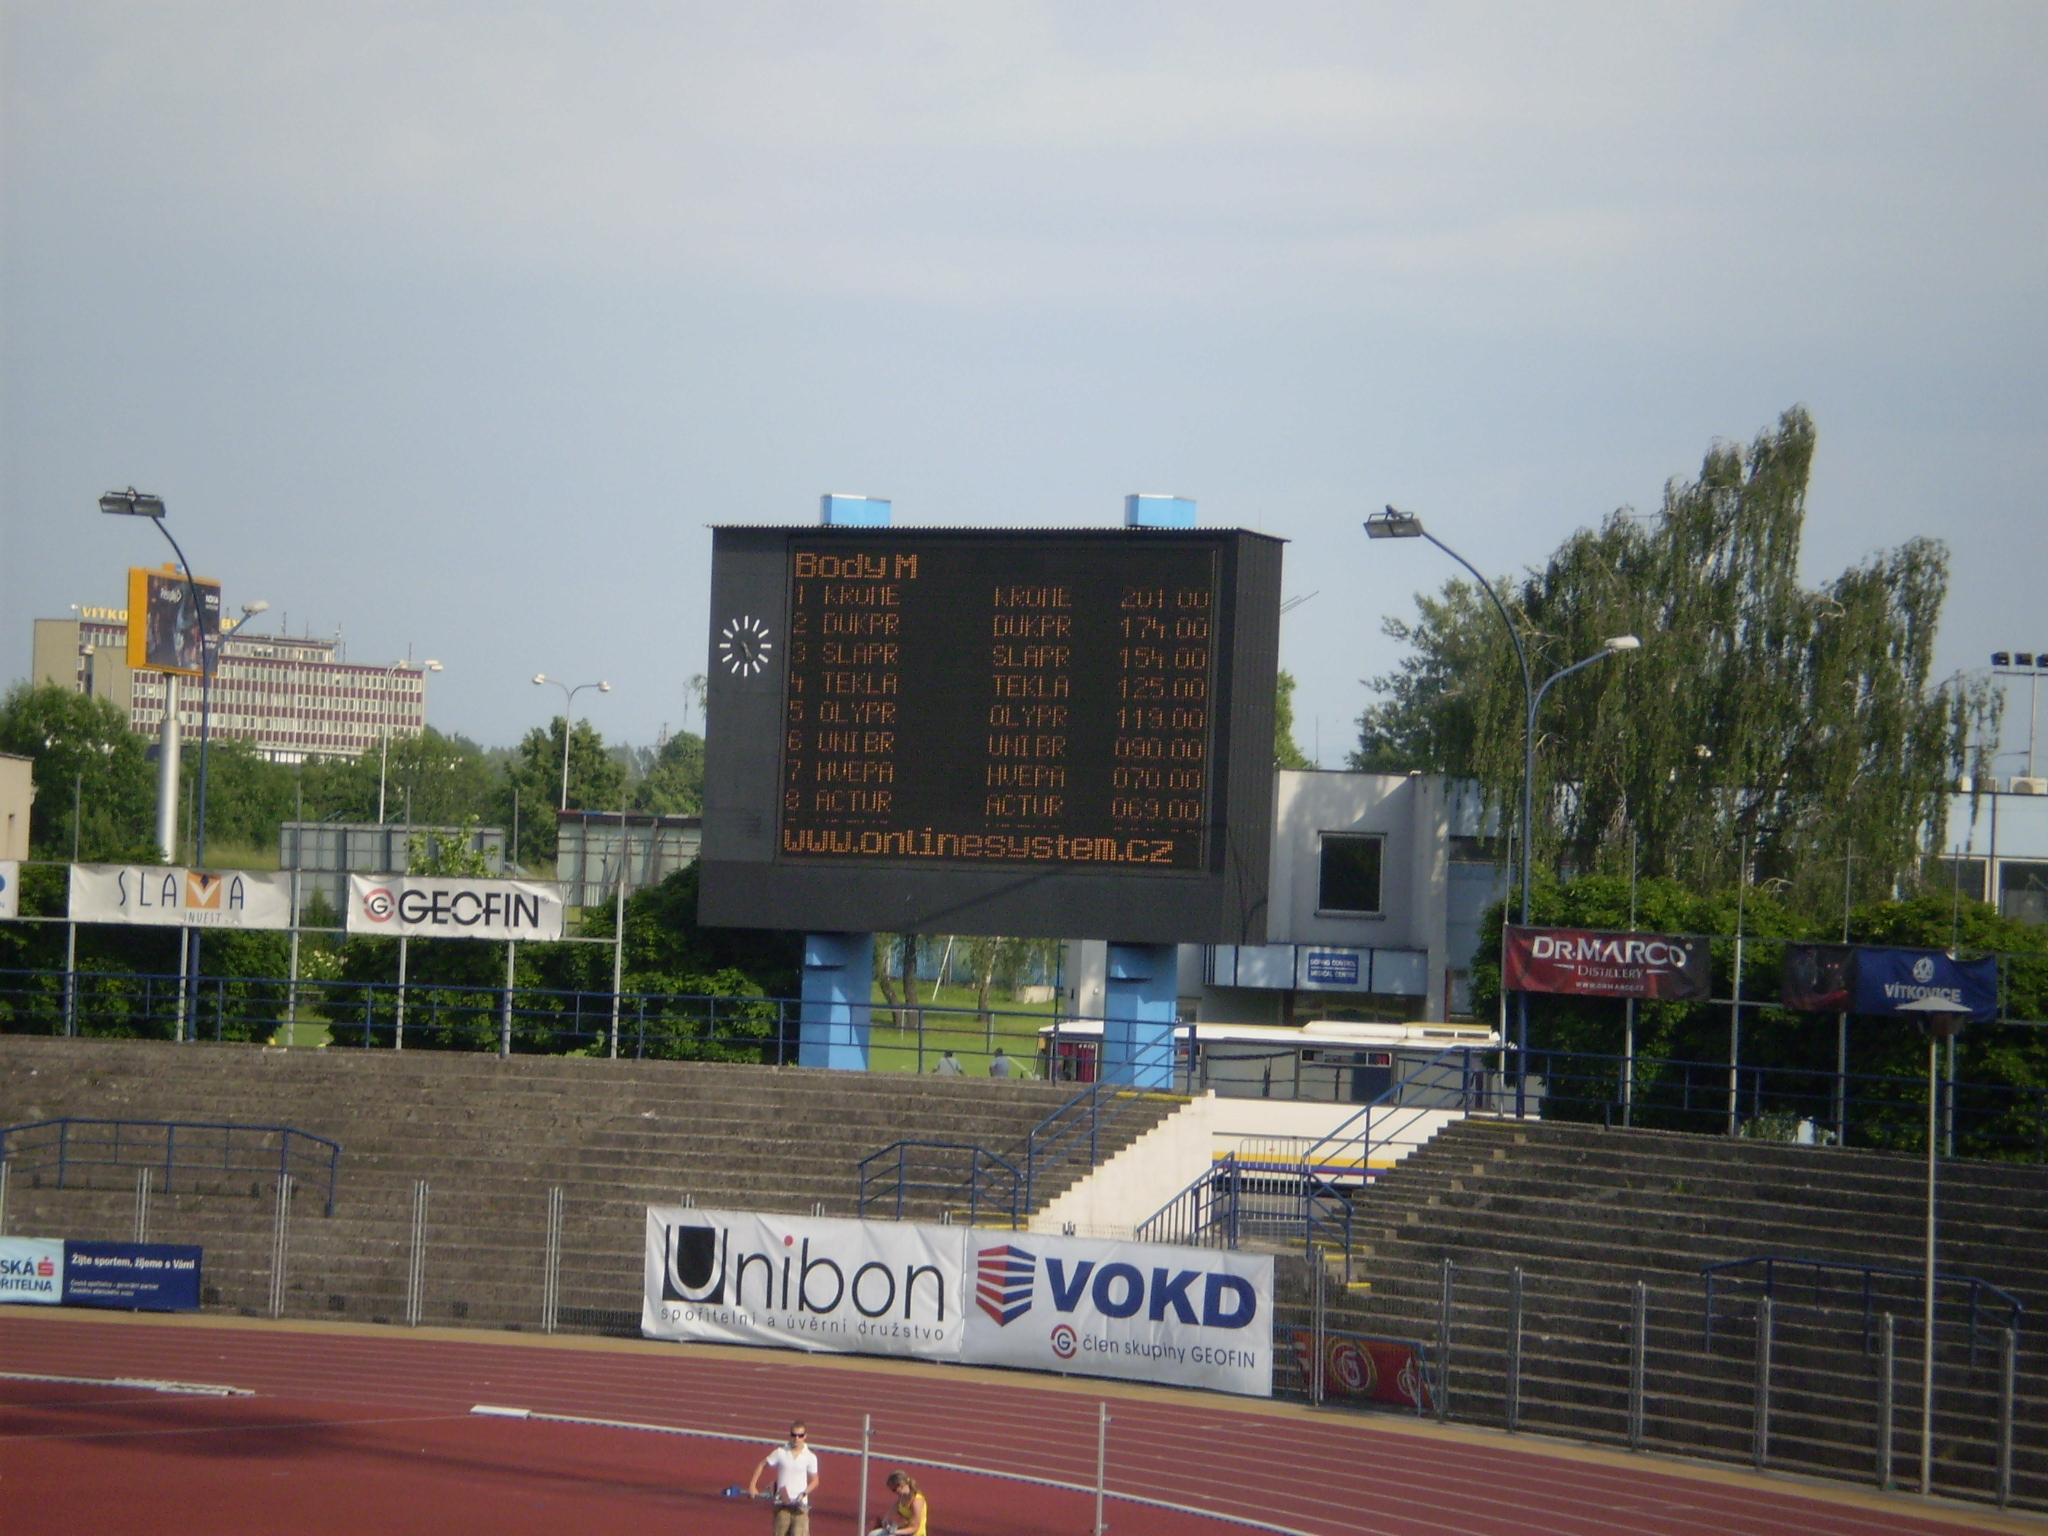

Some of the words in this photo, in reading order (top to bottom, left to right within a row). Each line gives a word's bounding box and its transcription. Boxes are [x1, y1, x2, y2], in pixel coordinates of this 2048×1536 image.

[796, 553, 886, 578] Body
[895, 554, 918, 578] M
[798, 585, 804, 605] 1
[793, 612, 807, 634] 2
[792, 642, 806, 663] 3
[822, 642, 899, 664] SLAPR
[993, 645, 1070, 667] SLAPR
[791, 671, 804, 693] 4
[822, 671, 897, 694] TEKLA
[993, 675, 1069, 697] TEKLA
[789, 700, 804, 721] 5
[820, 701, 896, 723] OLYPR
[990, 705, 1067, 727] OLYPR
[788, 729, 802, 751] 6
[1115, 736, 1202, 759] 090.00
[787, 759, 801, 781] 7
[1113, 766, 1201, 790] 070.00
[785, 788, 799, 811] 8
[815, 789, 893, 812] ACTUR
[986, 793, 1063, 817] ACTUR
[783, 827, 1174, 864] www.onlinesystem.cz
[399, 889, 539, 928] GEOFIN
[0, 1276, 52, 1292] ŘITELNA
[662, 1224, 945, 1323] Unibon
[1045, 1258, 1257, 1330] VOKD
[767, 1316, 776, 1327] a
[858, 1322, 944, 1341] družstvo
[1083, 1334, 1119, 1354] člen
[1125, 1341, 1186, 1364] skupiny
[1191, 1345, 1255, 1369] GEOFIN
